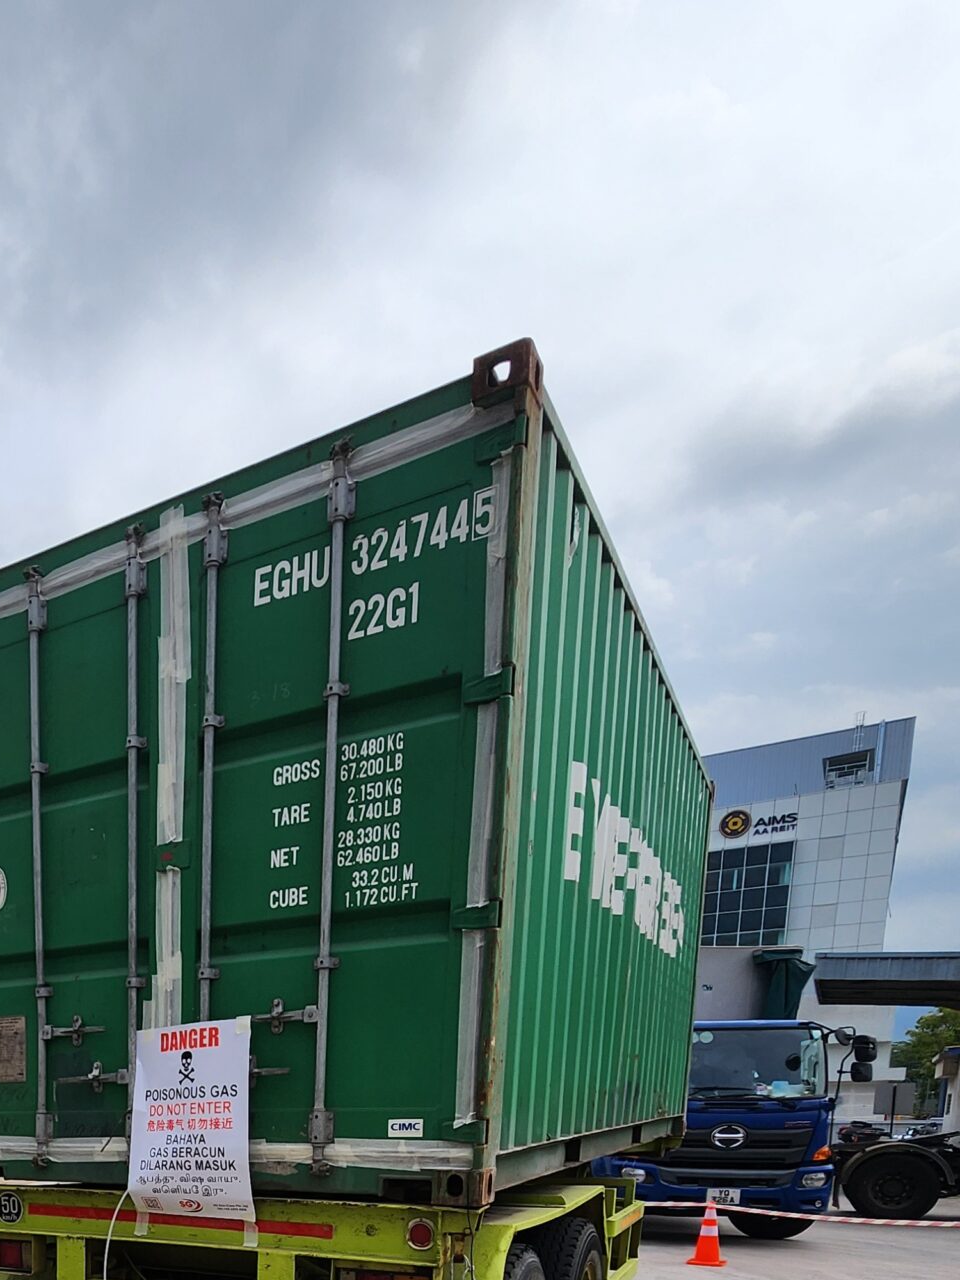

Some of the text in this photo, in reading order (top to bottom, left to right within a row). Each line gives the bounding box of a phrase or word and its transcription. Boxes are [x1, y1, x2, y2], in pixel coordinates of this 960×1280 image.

[253, 487, 498, 607] EGHU 3247445
[347, 581, 420, 641] 22G1
[341, 732, 404, 762] 30.480 KG
[272, 752, 403, 786] GROSS 67.200 LB
[347, 777, 402, 804] 2.150 KG
[272, 798, 401, 828] TARE 4.740 LB
[753, 812, 799, 829] AIMS
[337, 822, 400, 848] 28.330 KG
[752, 823, 798, 836] AA REIT
[270, 842, 399, 869] NET 62.460 LB
[351, 868, 379, 888] 33.2
[269, 886, 309, 909] CUBE
[344, 889, 378, 909] 1.172
[160, 1026, 220, 1053] DANGER
[145, 1083, 238, 1102] POISONOUS GAS
[149, 1101, 232, 1117] DO NOT ENTER
[146, 1117, 233, 1132] 危险毒气 切勿接近
[390, 1122, 421, 1132] CIMC
[165, 1133, 206, 1145] BAHAYA
[149, 1146, 225, 1158] GAS BERACUN
[139, 1159, 237, 1171] DILARANG MASUK
[1, 1196, 19, 1214] 50
[178, 1199, 194, 1208] SG
